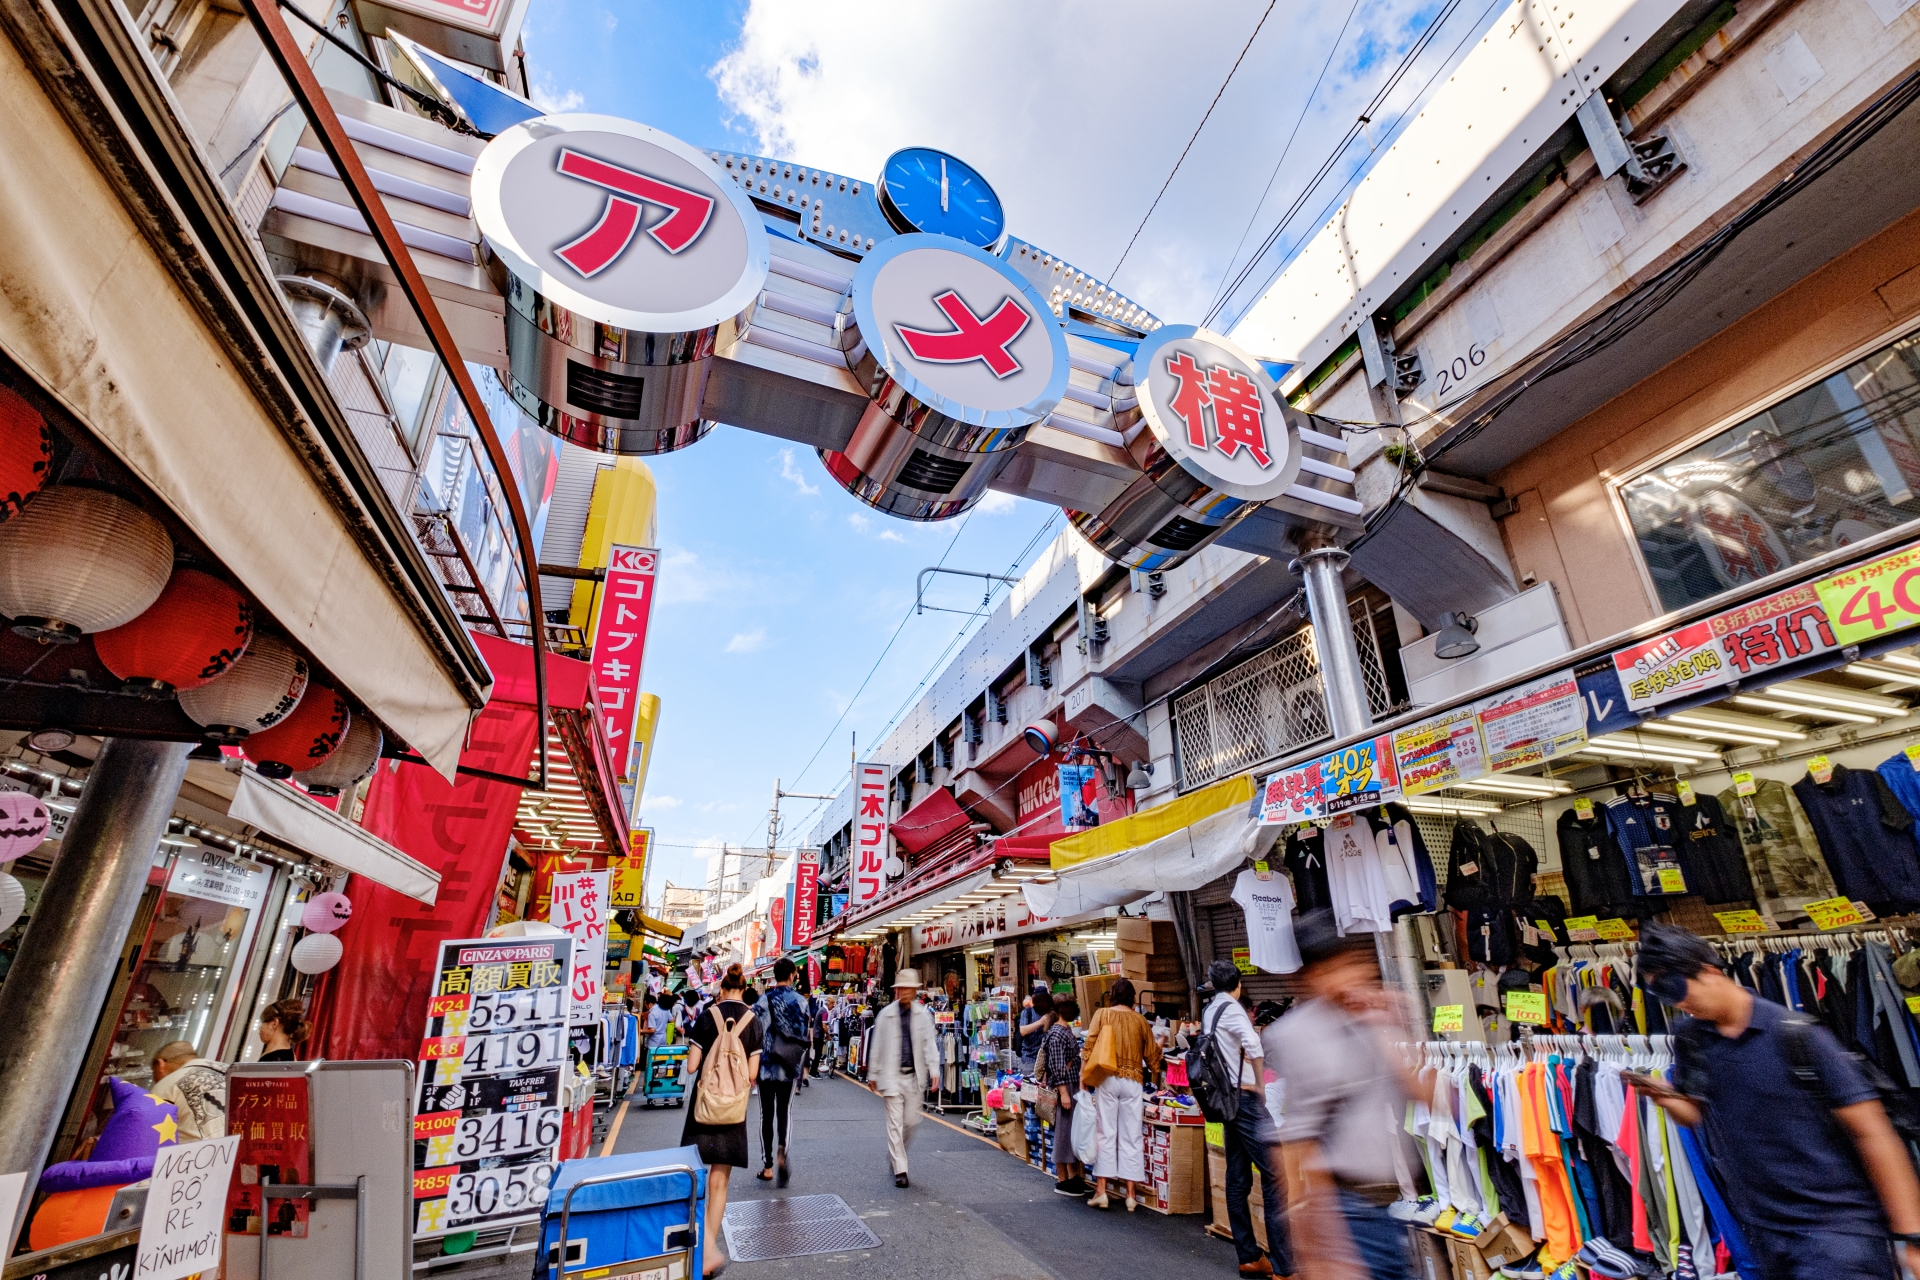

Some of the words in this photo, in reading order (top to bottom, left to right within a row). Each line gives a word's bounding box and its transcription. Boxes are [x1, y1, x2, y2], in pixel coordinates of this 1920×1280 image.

[552, 145, 716, 279] ア
[1164, 349, 1276, 471] 横
[1435, 342, 1488, 397] 206
[612, 548, 656, 572] KG
[1723, 605, 1838, 674] 特价
[598, 578, 645, 757] コトブキゴル
[1634, 635, 1683, 675] SALE!
[1629, 649, 1722, 700] 尽快抢购
[1071, 688, 1086, 711] 207
[1266, 761, 1324, 805] 総決算
[1404, 758, 1451, 787] 15%OFF
[1291, 787, 1327, 812] セール
[858, 768, 886, 900] 二木ゴルフ
[629, 834, 646, 870] 御徒町
[577, 877, 604, 939] #もっと
[613, 892, 635, 902] 入口
[797, 866, 815, 943] コトブキゴルフ
[1252, 894, 1282, 903] Reebok
[463, 950, 501, 962] GINZA
[515, 946, 551, 959] PARIS
[440, 960, 561, 996] 高額買取
[433, 999, 465, 1013] K24
[426, 1043, 459, 1056] K18
[426, 1087, 439, 1095] 2F
[509, 1076, 546, 1087] TAX-FREE
[238, 1094, 298, 1109] ブランド品
[470, 1097, 481, 1106] 1F
[232, 1121, 305, 1141] 高価買取
